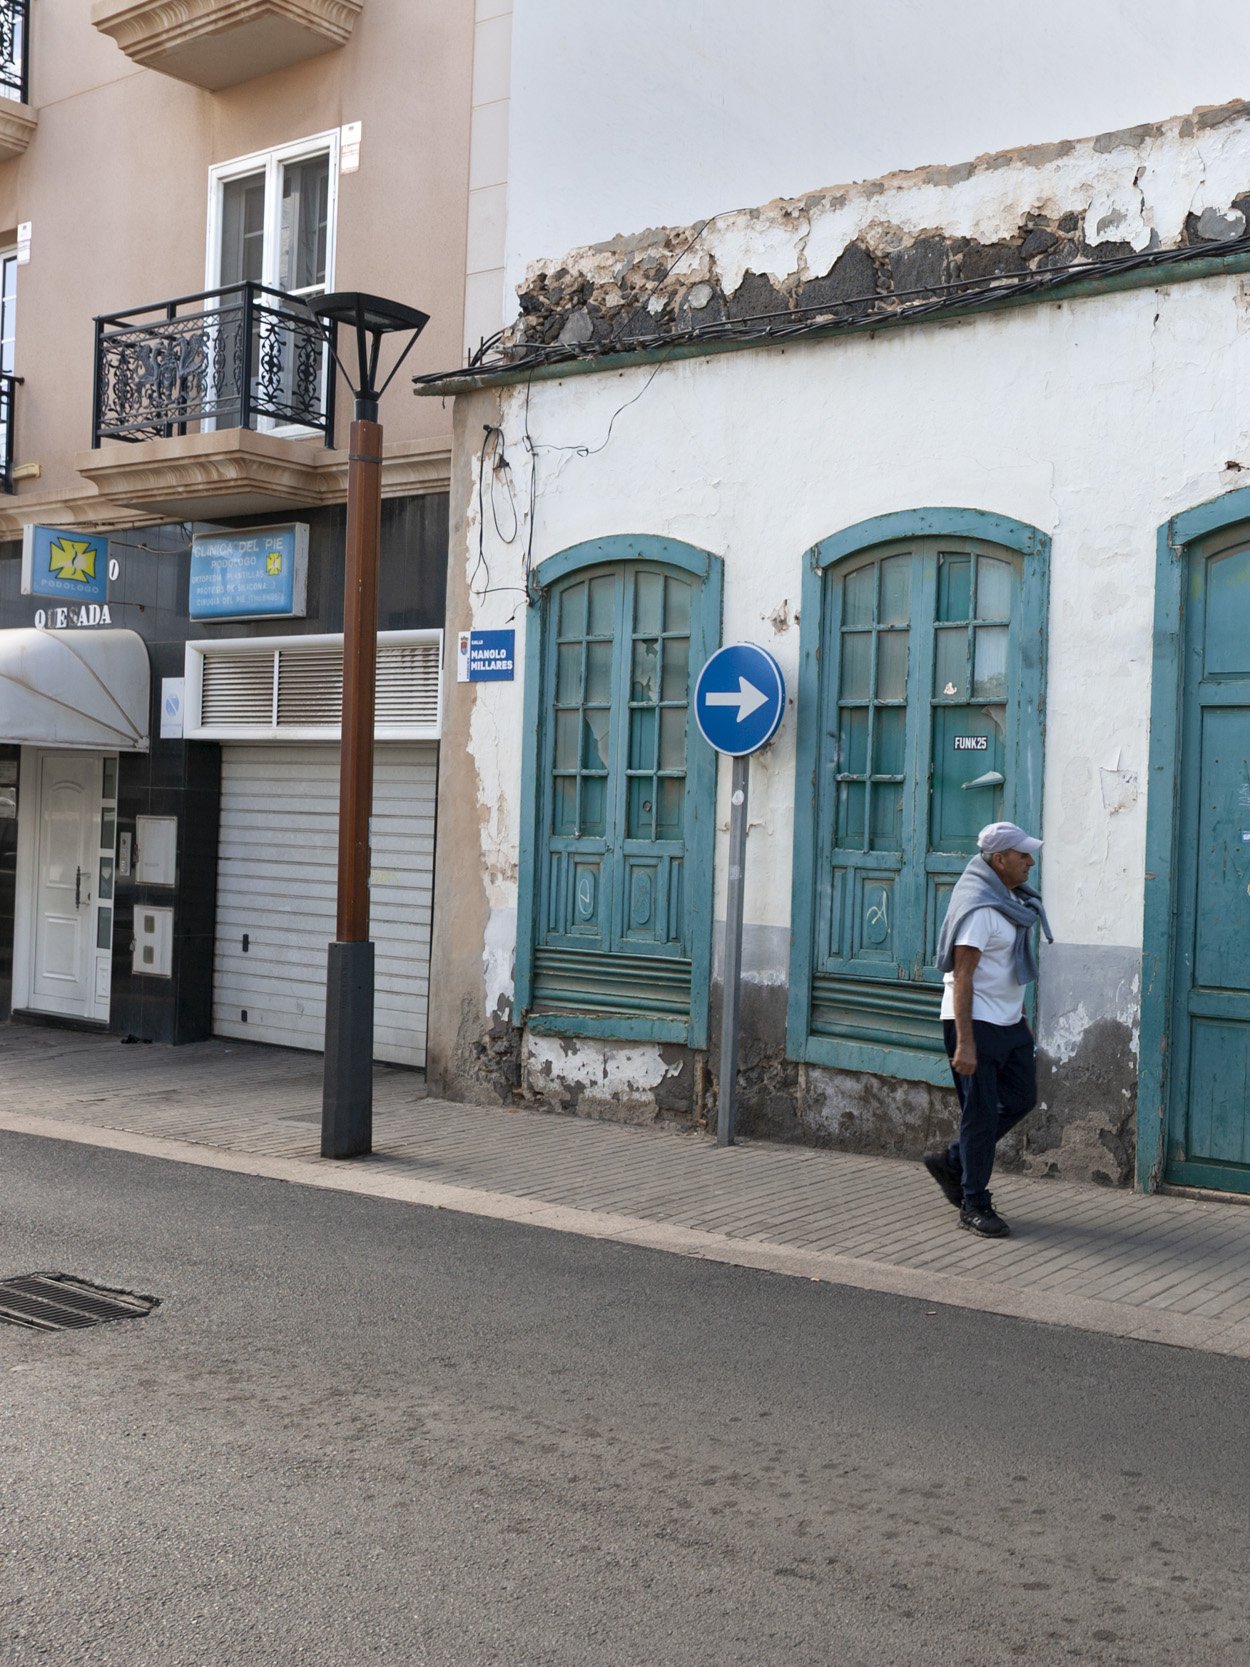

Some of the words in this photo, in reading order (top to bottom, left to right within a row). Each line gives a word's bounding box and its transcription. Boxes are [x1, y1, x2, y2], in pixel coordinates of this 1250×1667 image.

[239, 539, 259, 552] DEL
[265, 538, 284, 549] PIE
[41, 579, 100, 594] PODOLOGO
[471, 649, 507, 659] MANOLO
[471, 660, 513, 671] MILLARES
[954, 737, 987, 749] FUNK25
